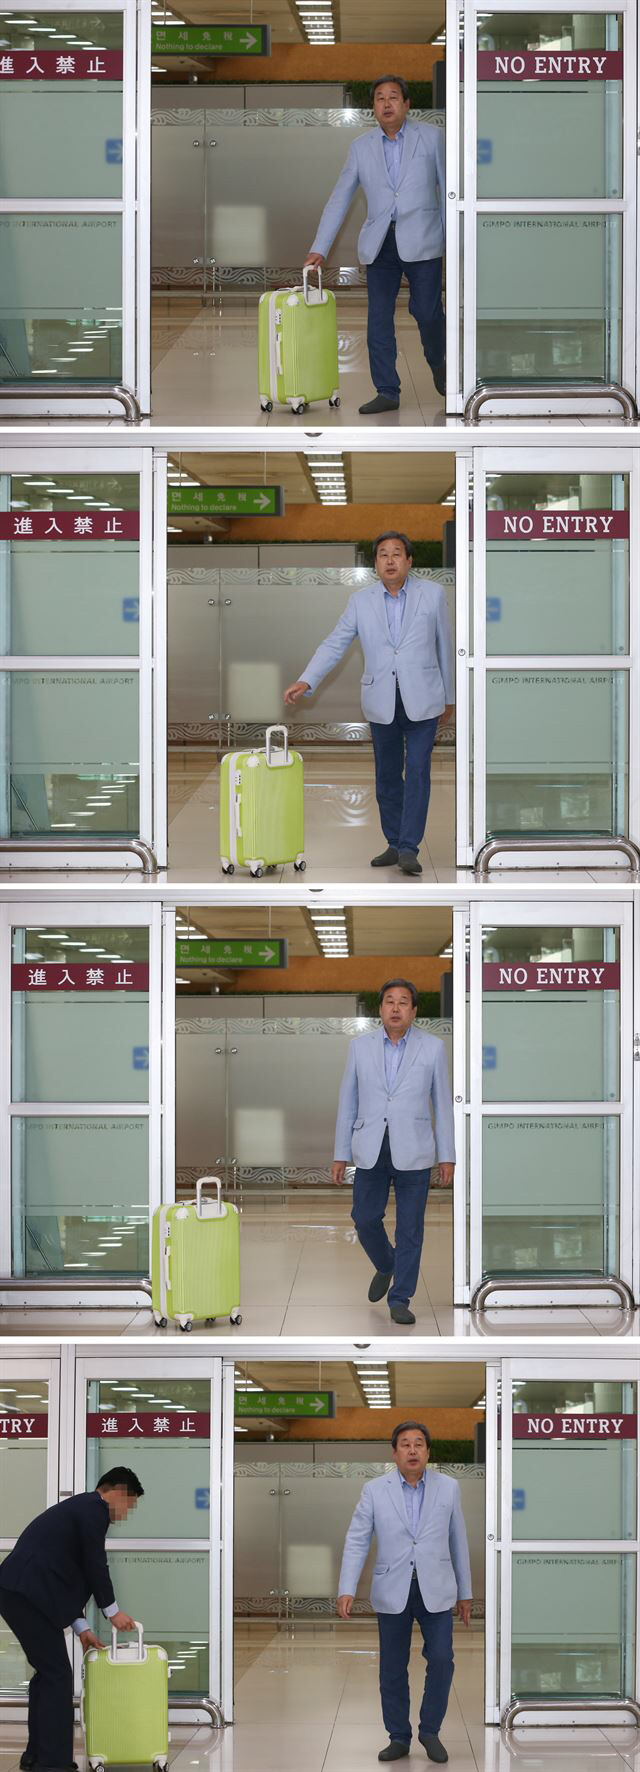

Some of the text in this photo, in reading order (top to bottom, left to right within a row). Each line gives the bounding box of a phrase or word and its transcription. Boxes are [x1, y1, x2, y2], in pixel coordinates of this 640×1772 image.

[155, 42, 184, 50] Nothing
[0, 56, 107, 74] 進入禁止
[495, 57, 607, 74] NO ENTRY
[482, 220, 511, 228] GIMPO
[513, 220, 580, 228] INTERNATIONAL
[171, 504, 200, 512] Nothing
[14, 516, 124, 535] 進入禁止
[504, 516, 614, 533] NO ENTRY
[522, 676, 587, 684] INTERNATIONAL
[28, 968, 133, 986] 進入禁止
[499, 968, 605, 984] NO ENTRY
[101, 1417, 196, 1433] 進入禁止
[527, 1418, 624, 1433] NO ENTRY
